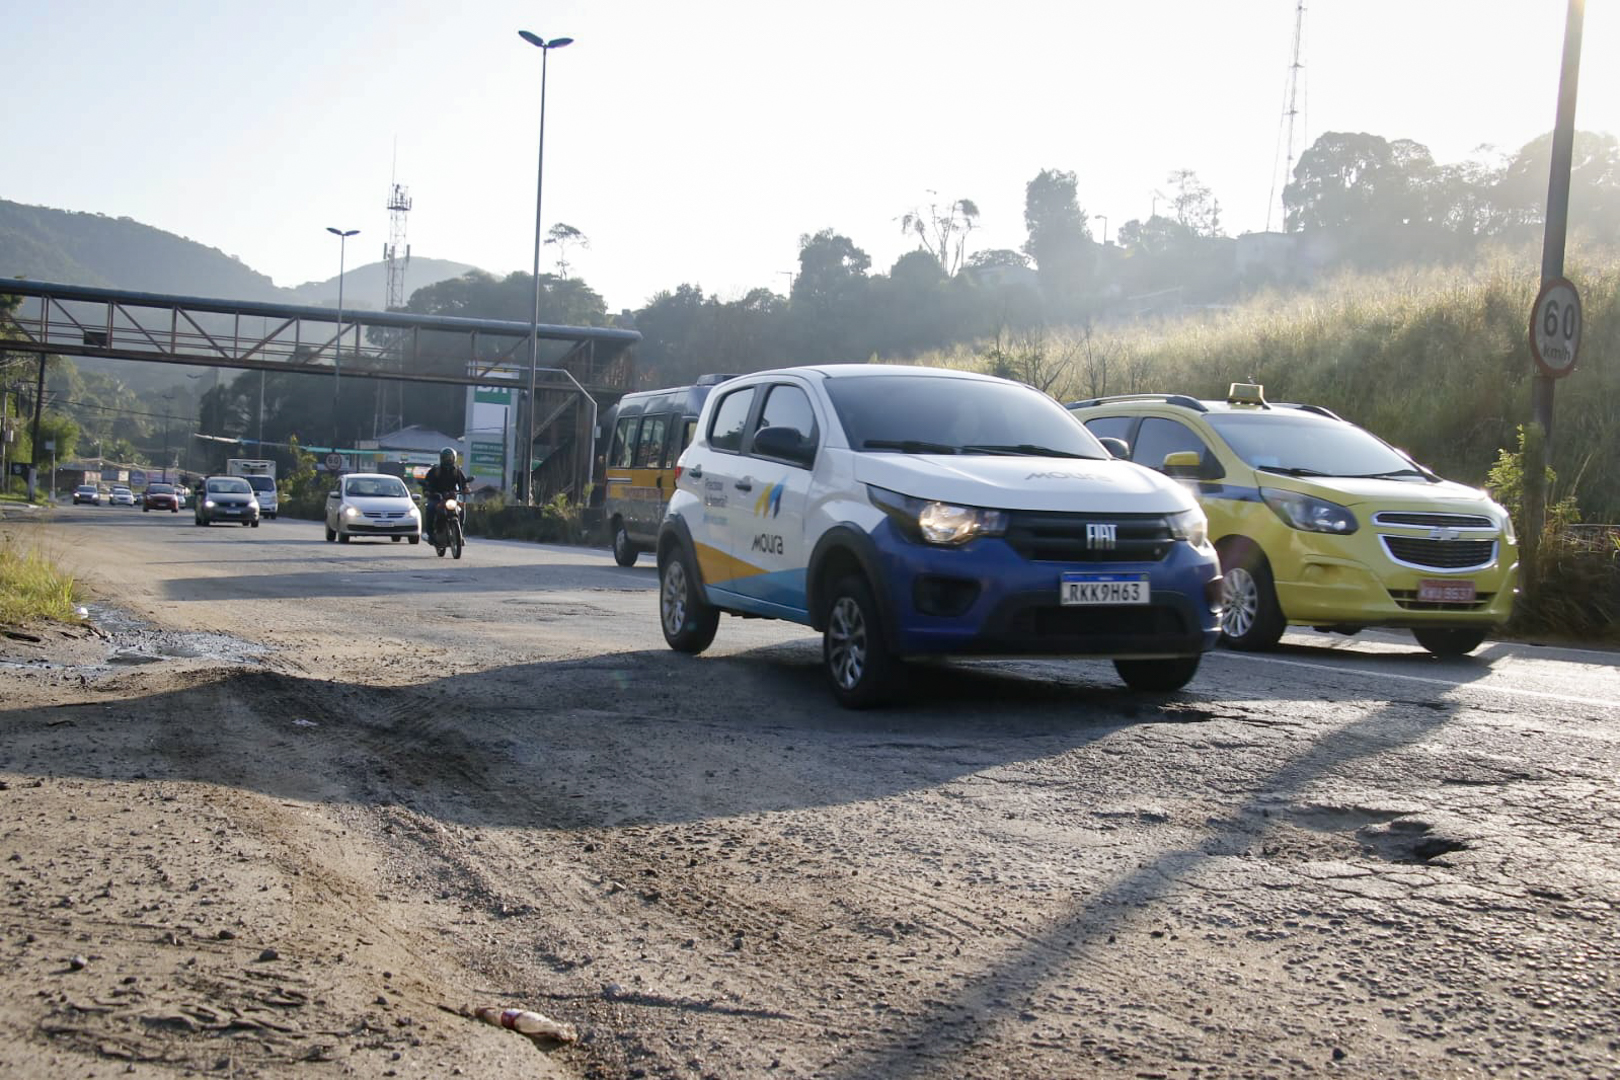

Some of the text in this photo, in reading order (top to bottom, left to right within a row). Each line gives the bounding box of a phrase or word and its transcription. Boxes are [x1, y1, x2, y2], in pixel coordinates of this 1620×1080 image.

[1543, 299, 1575, 341] 60
[1085, 523, 1118, 550] FIAT
[1069, 583, 1140, 601] RKK9H63
